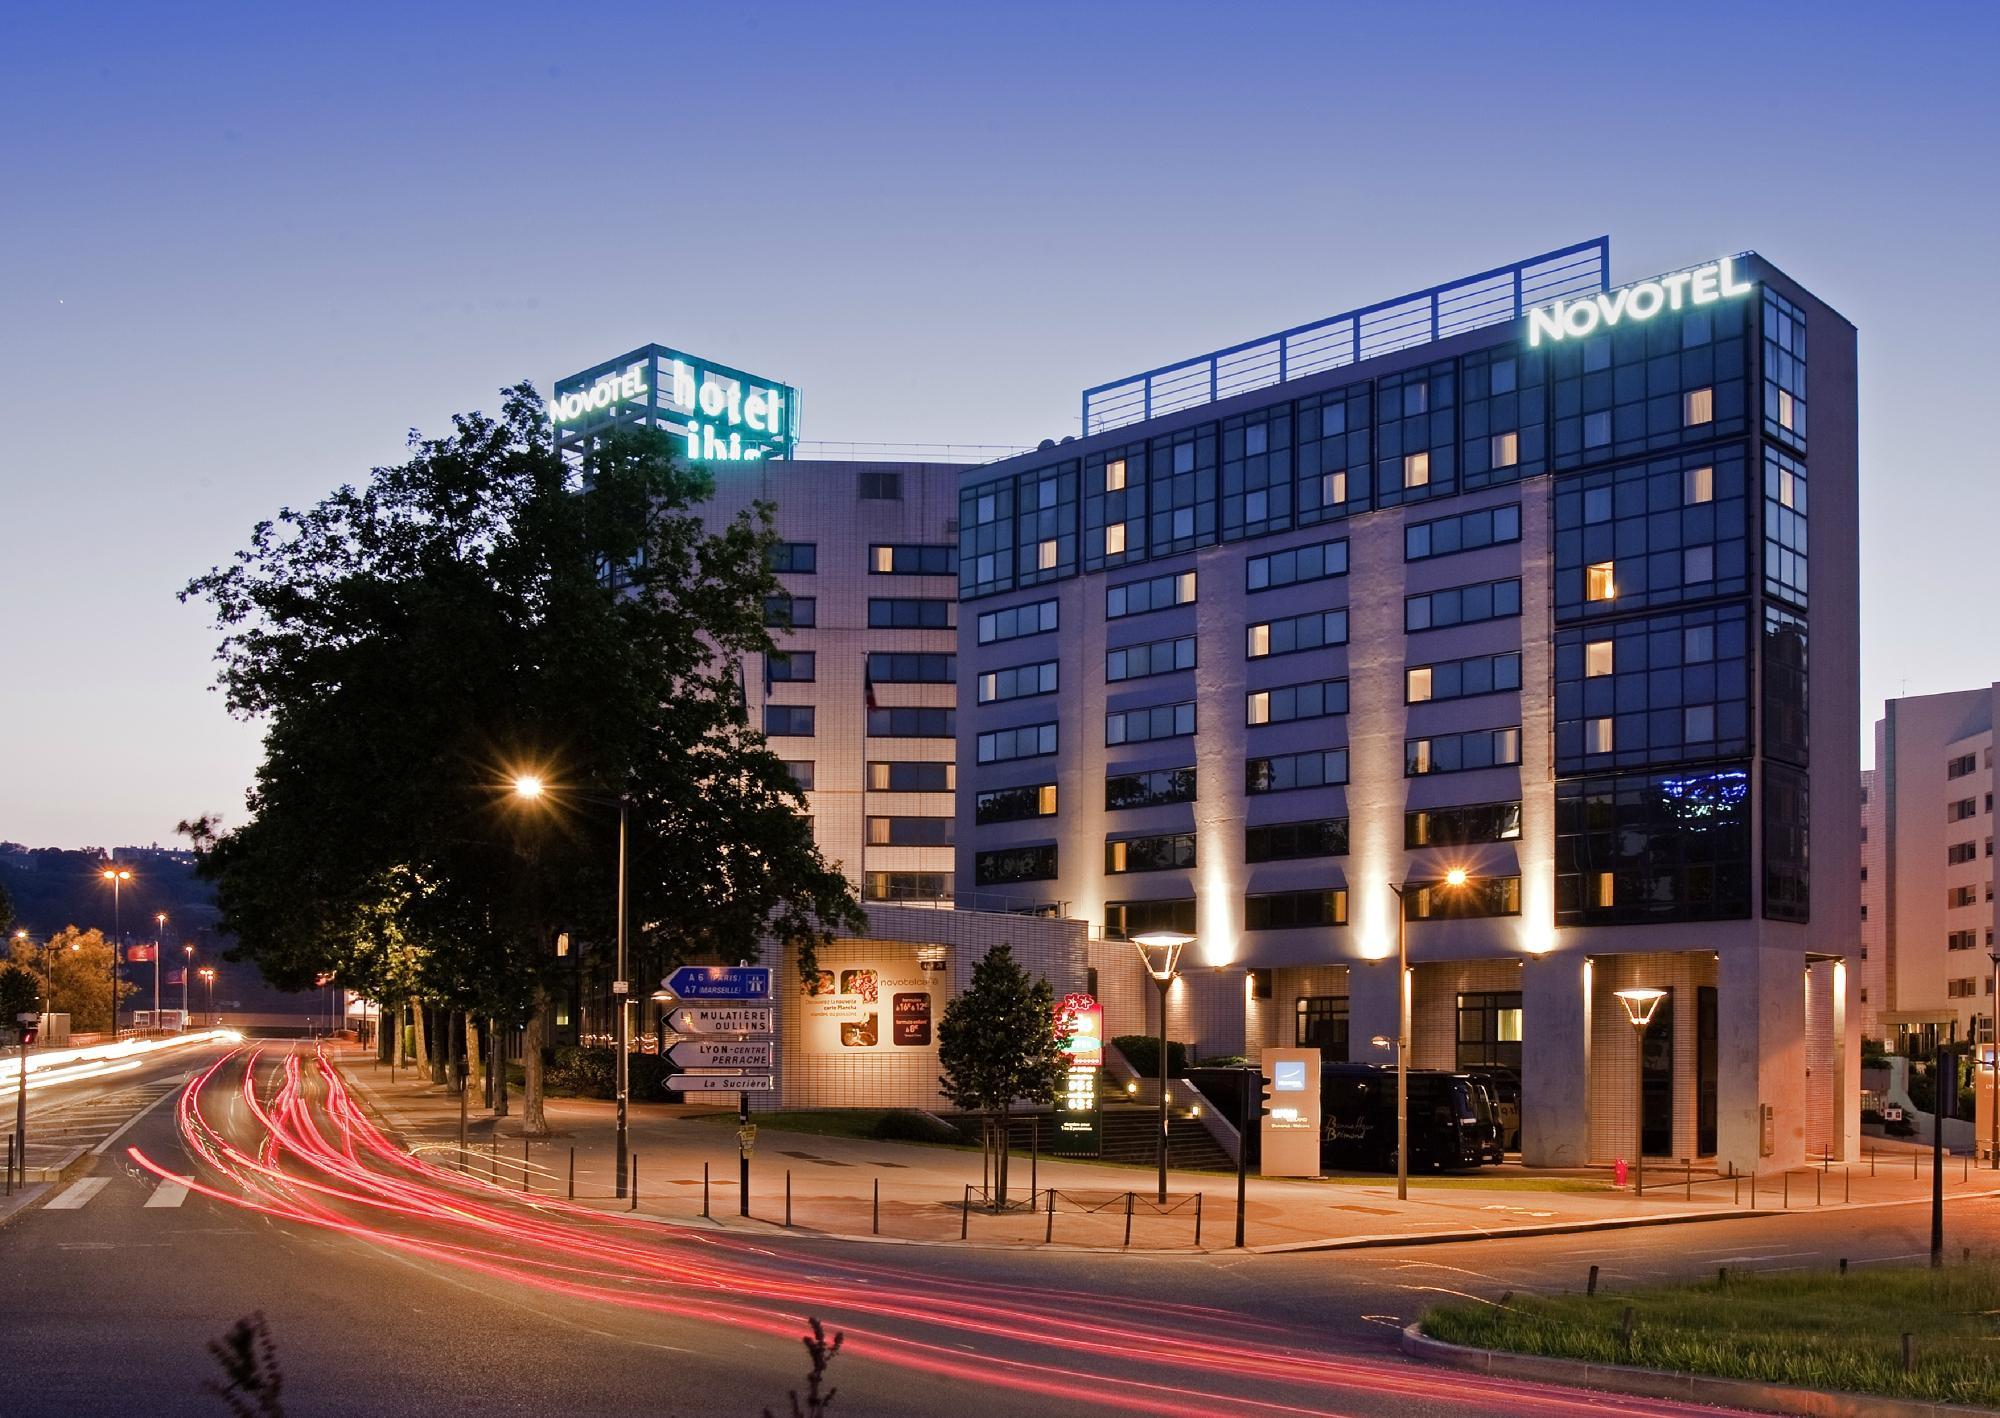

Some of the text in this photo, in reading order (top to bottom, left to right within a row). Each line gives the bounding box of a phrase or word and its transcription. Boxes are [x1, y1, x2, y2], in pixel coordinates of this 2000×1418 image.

[1529, 257, 1751, 347] NOVOTEL
[549, 366, 648, 424] NOVOTEL
[673, 359, 779, 434] hotel
[684, 985, 696, 994] A7
[700, 1009, 766, 1020] MULATIÈRE
[715, 1022, 766, 1030] OULLINS
[712, 1056, 767, 1064] PERRACHE
[704, 1079, 767, 1088] La Sucrière
